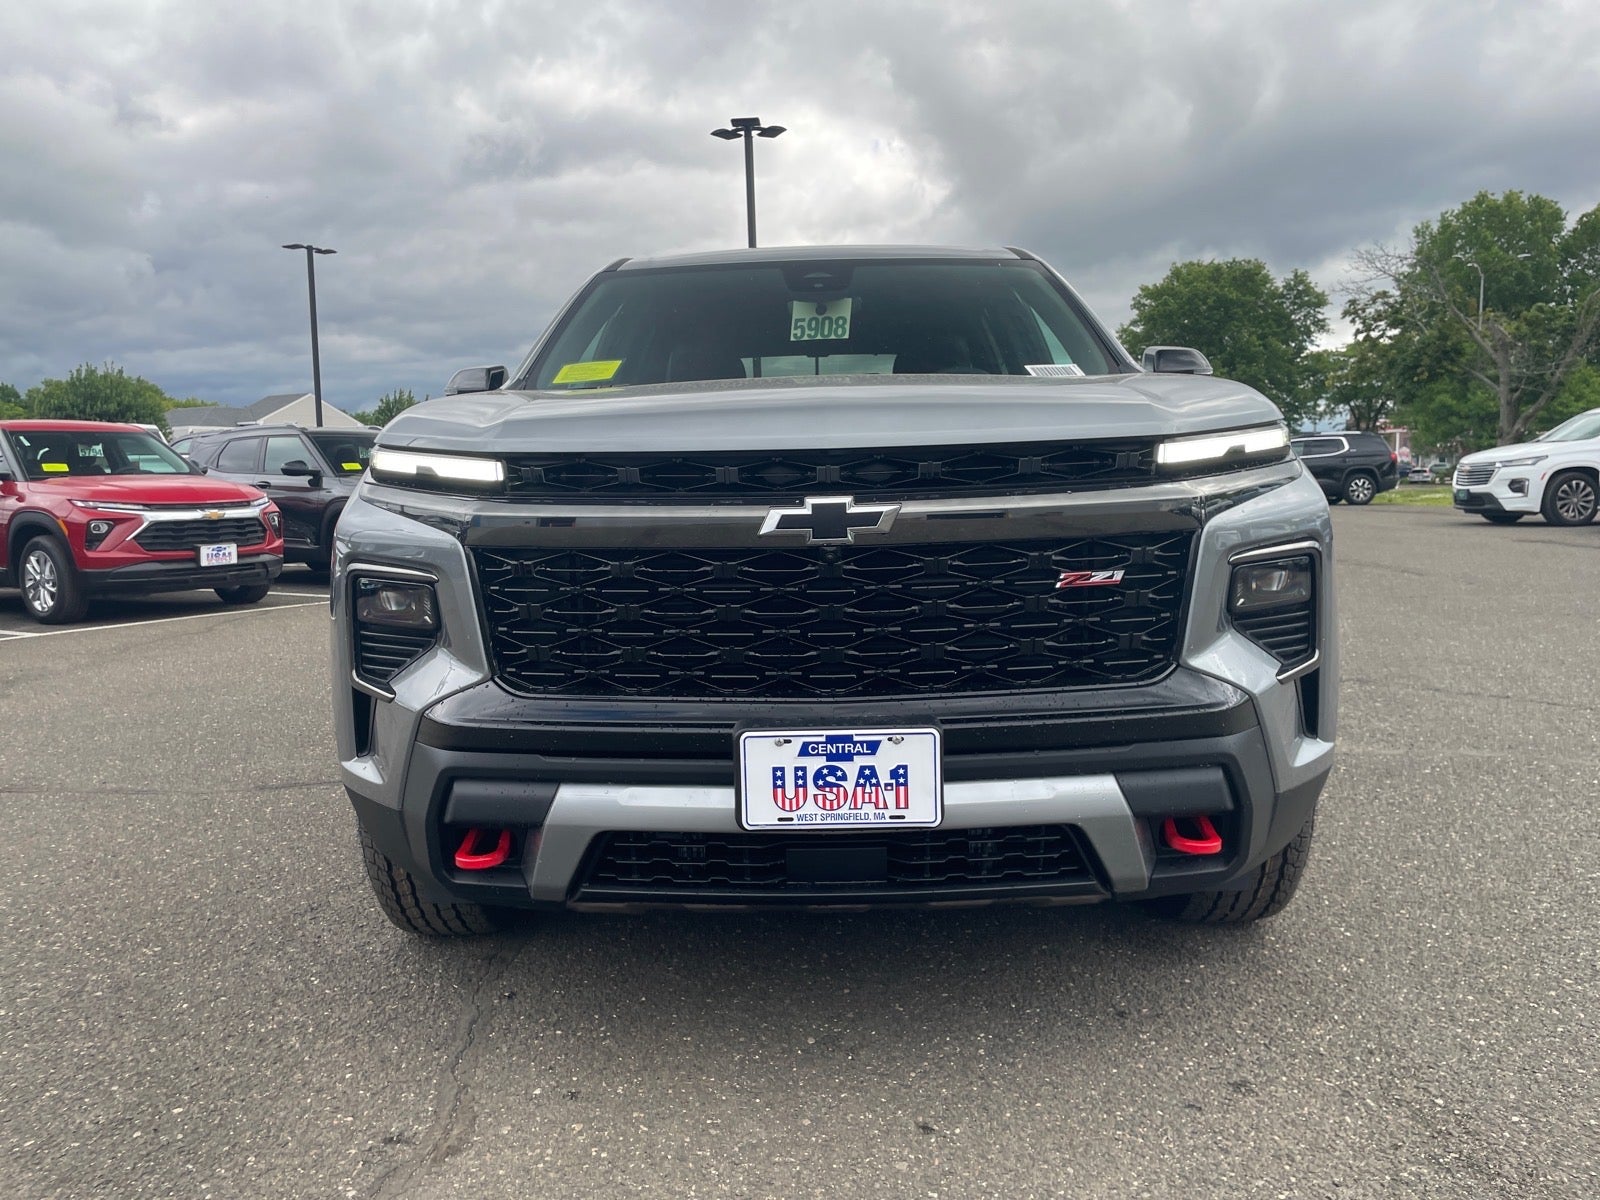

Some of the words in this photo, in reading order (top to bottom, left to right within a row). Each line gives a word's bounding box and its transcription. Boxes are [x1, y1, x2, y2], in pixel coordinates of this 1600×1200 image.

[793, 316, 847, 340] 5908
[1055, 570, 1125, 588] Z71
[808, 743, 872, 754] CENTRAL
[772, 764, 909, 812] USA-1
[796, 813, 819, 822] WEST
[820, 813, 872, 822] SPRINGFIELD,
[873, 812, 886, 821] MA
